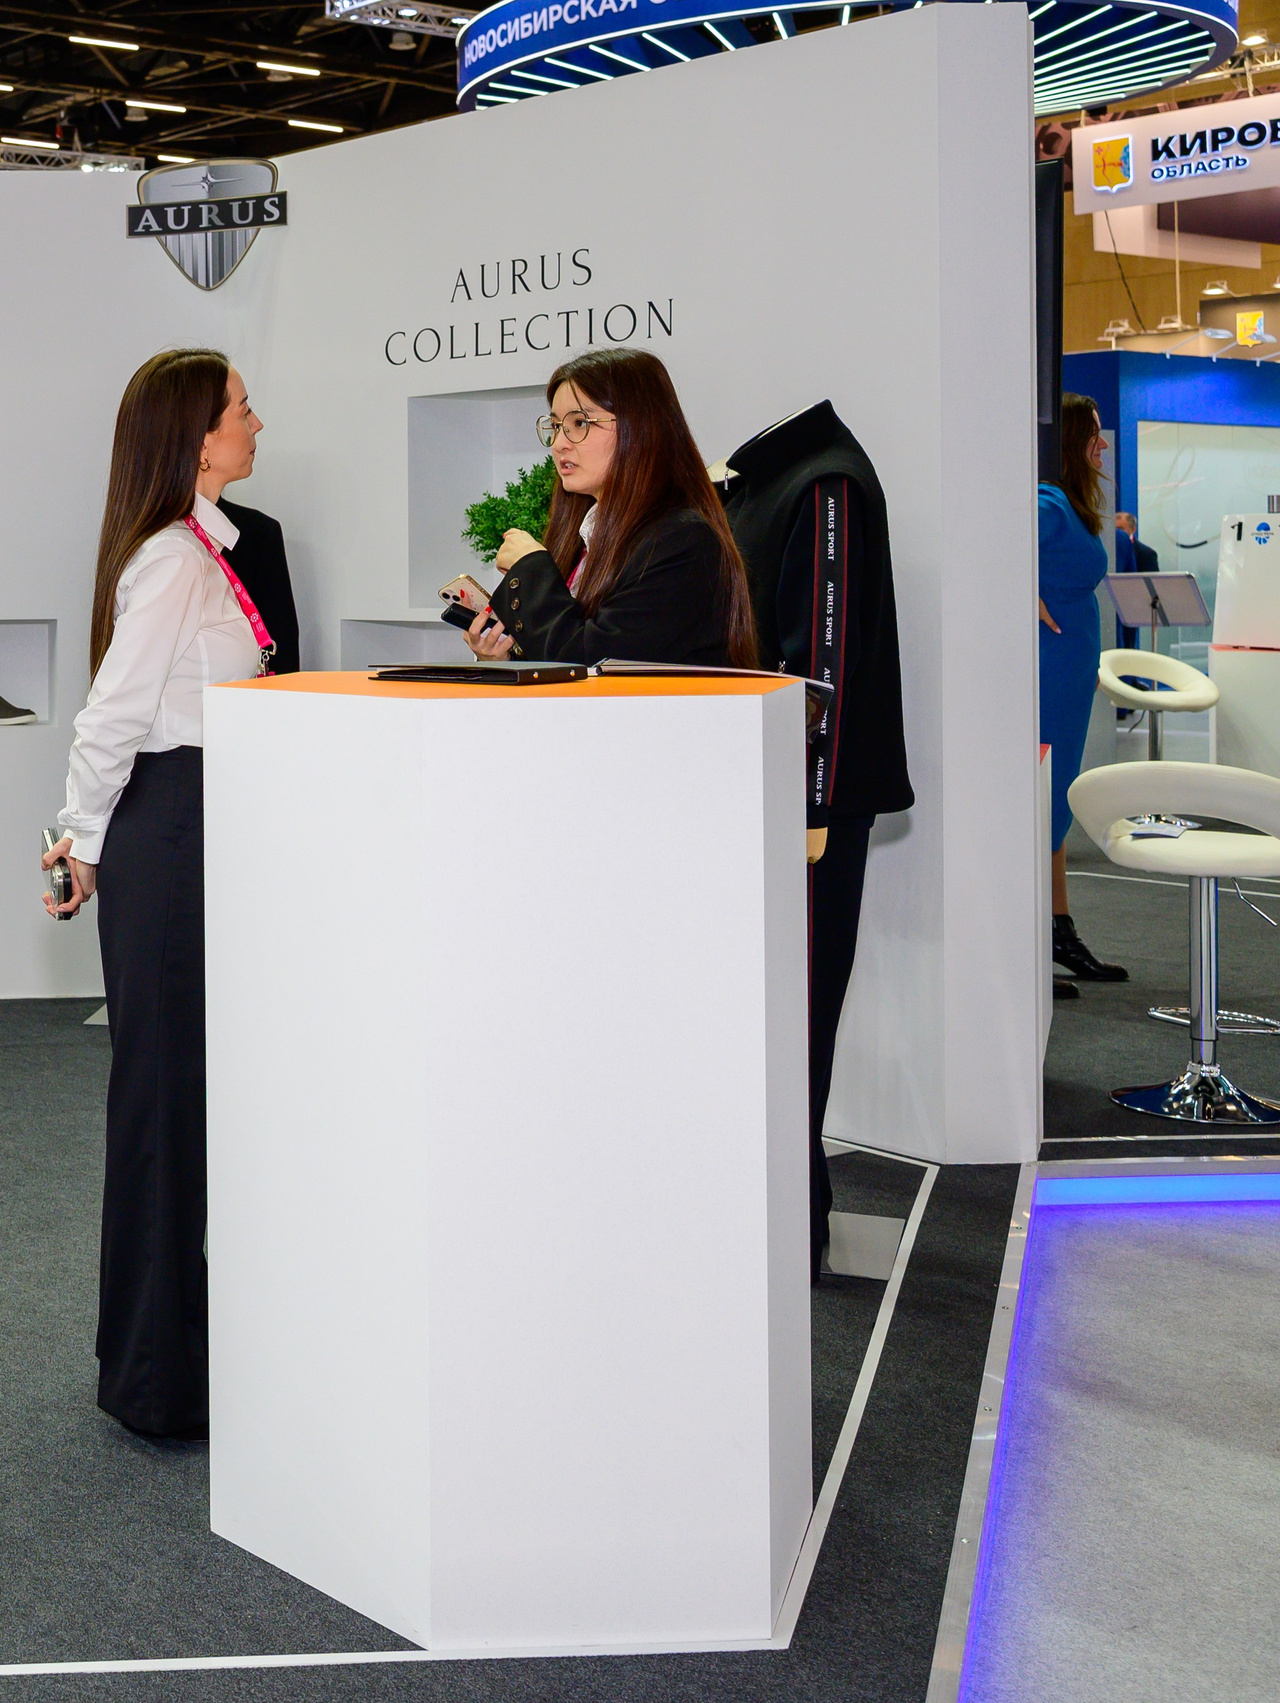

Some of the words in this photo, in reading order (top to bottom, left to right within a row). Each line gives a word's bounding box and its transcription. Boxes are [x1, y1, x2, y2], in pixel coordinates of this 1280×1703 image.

[1151, 155, 1249, 180] ОБЛАСТЬ
[134, 197, 280, 232] AURUS
[450, 248, 592, 303] AURUS
[385, 298, 673, 366] COLLECTION
[827, 496, 835, 529] AURUS
[827, 531, 835, 561] SPORT
[1230, 521, 1243, 541] 1
[826, 580, 834, 614] AURUS
[825, 617, 833, 647] SPORT
[816, 756, 825, 790] AURUS
